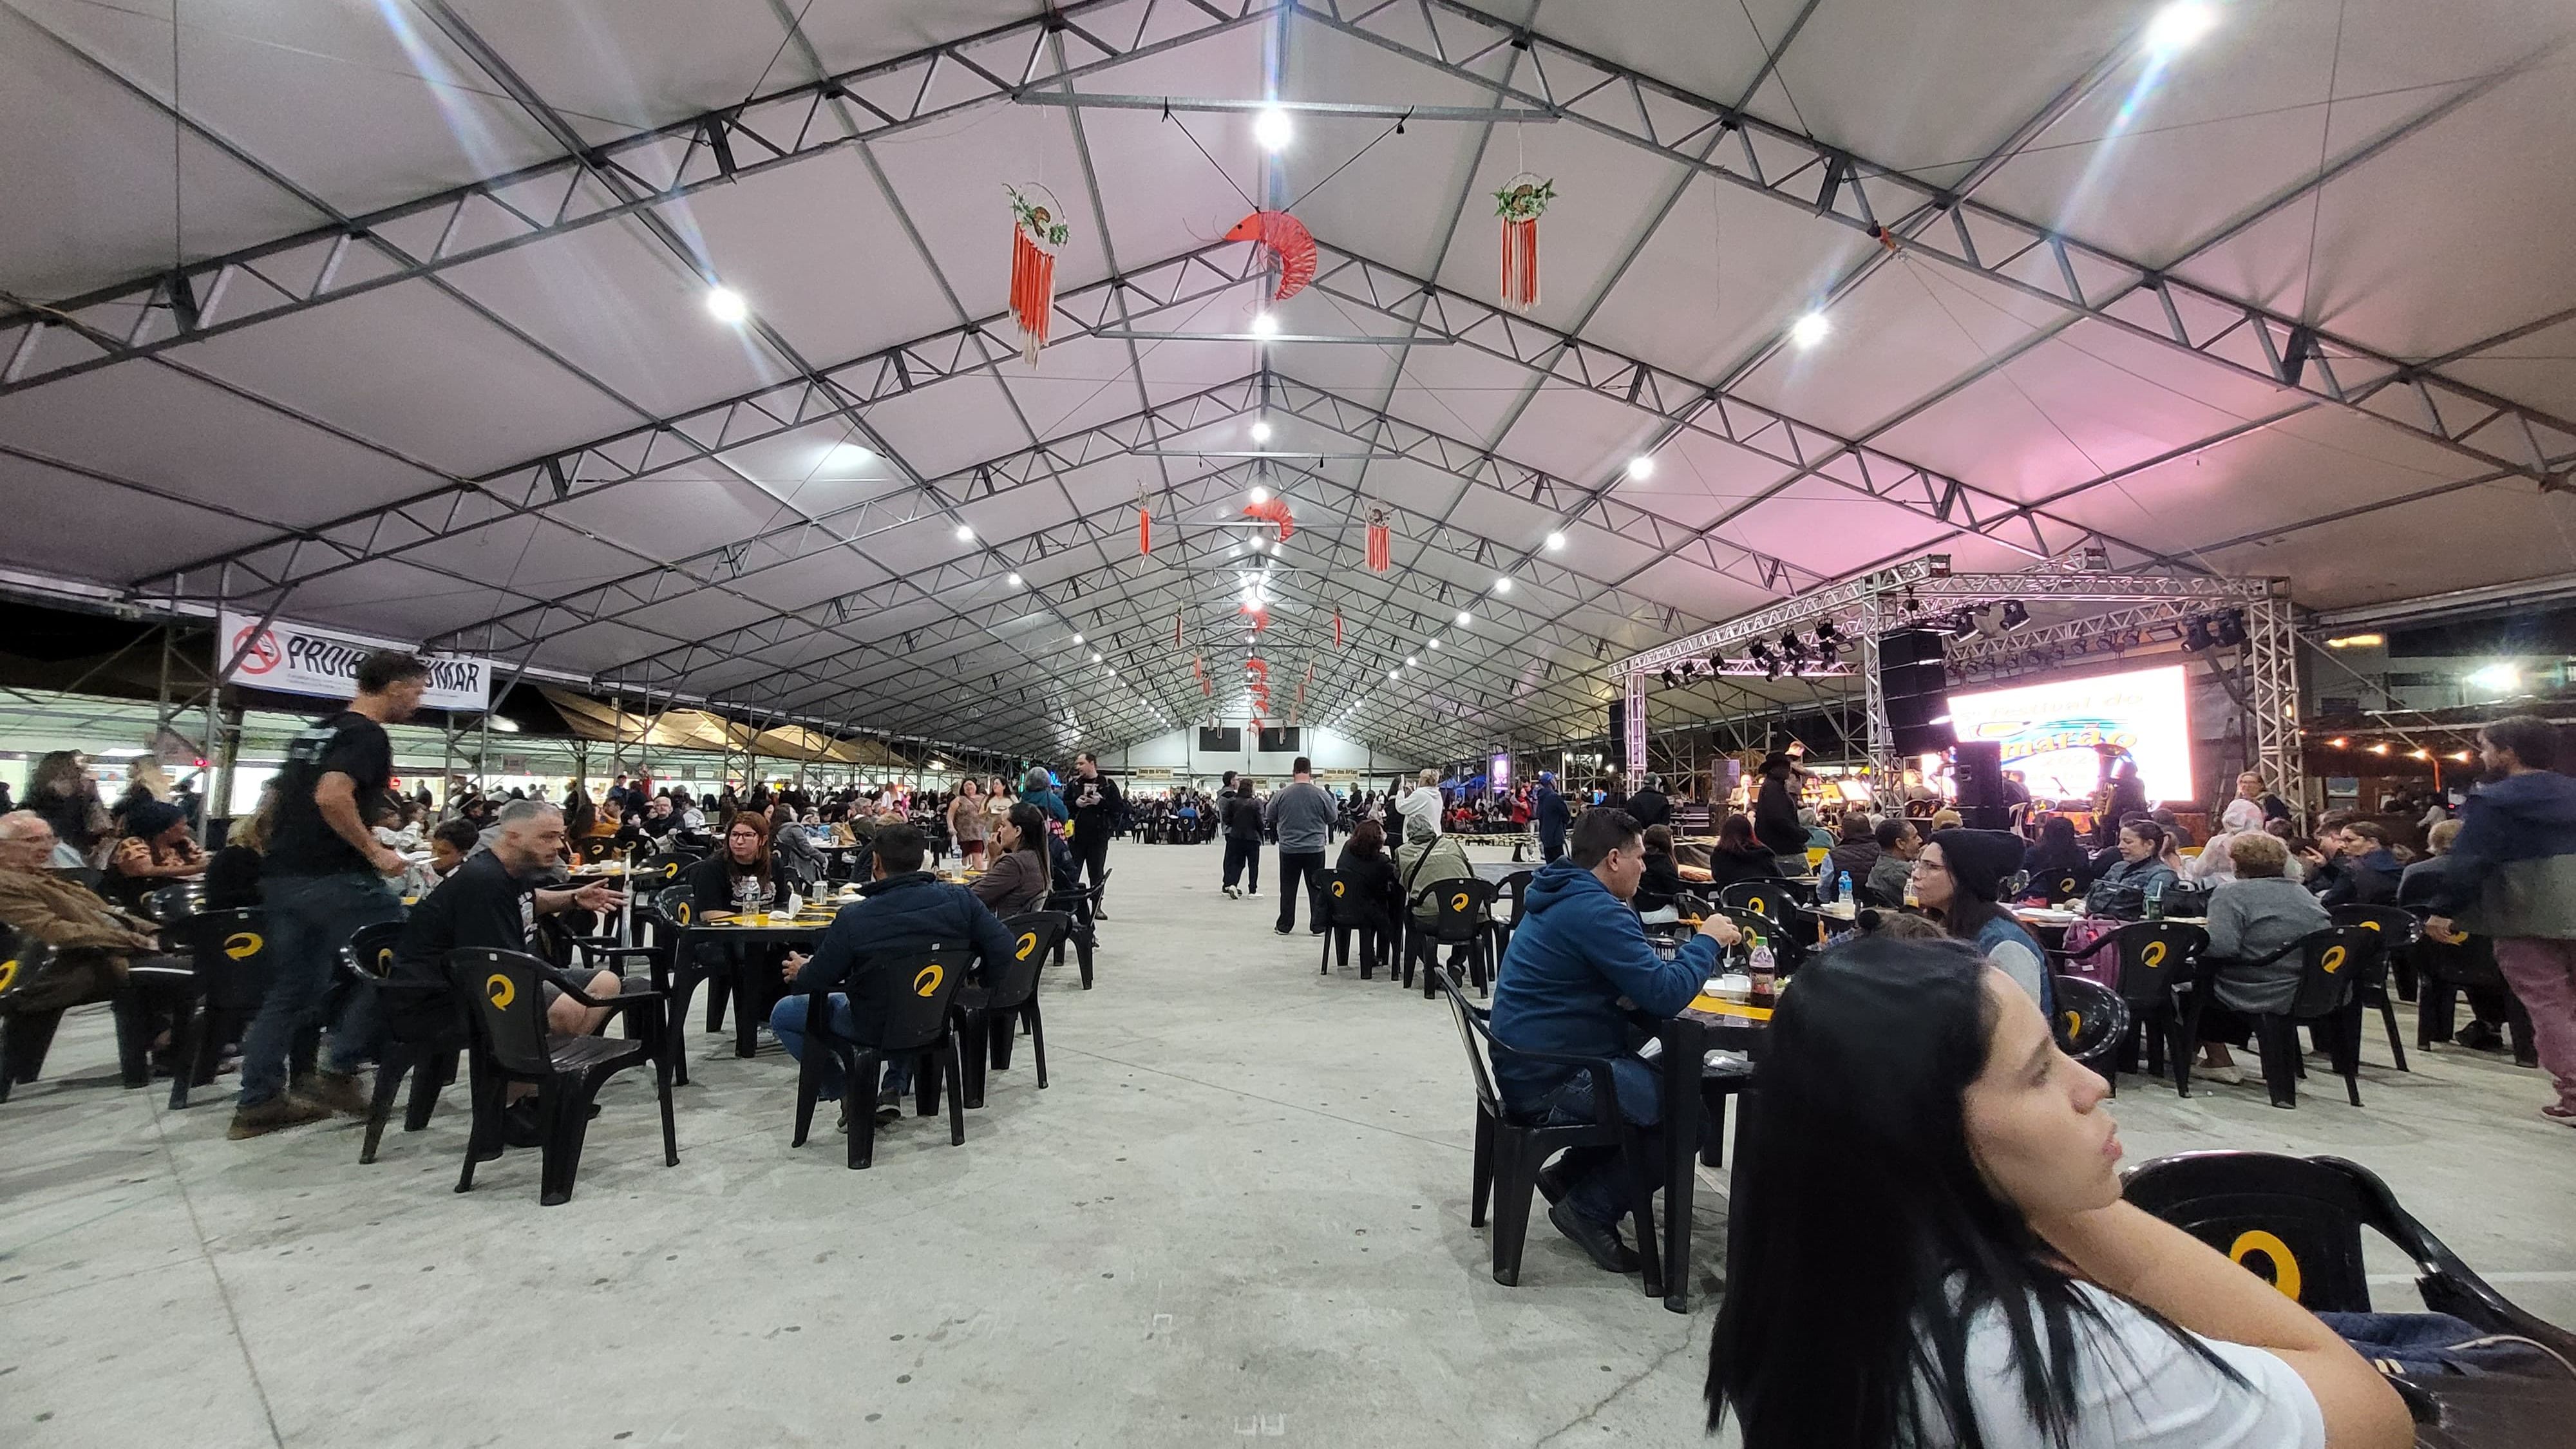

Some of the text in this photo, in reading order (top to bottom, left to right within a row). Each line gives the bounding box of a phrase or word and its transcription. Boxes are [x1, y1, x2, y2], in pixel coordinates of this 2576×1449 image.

[1990, 696, 2091, 719] Festival
[2102, 691, 2143, 707] do
[2000, 723, 2138, 759] marão
[1654, 947, 1676, 961] AHM
